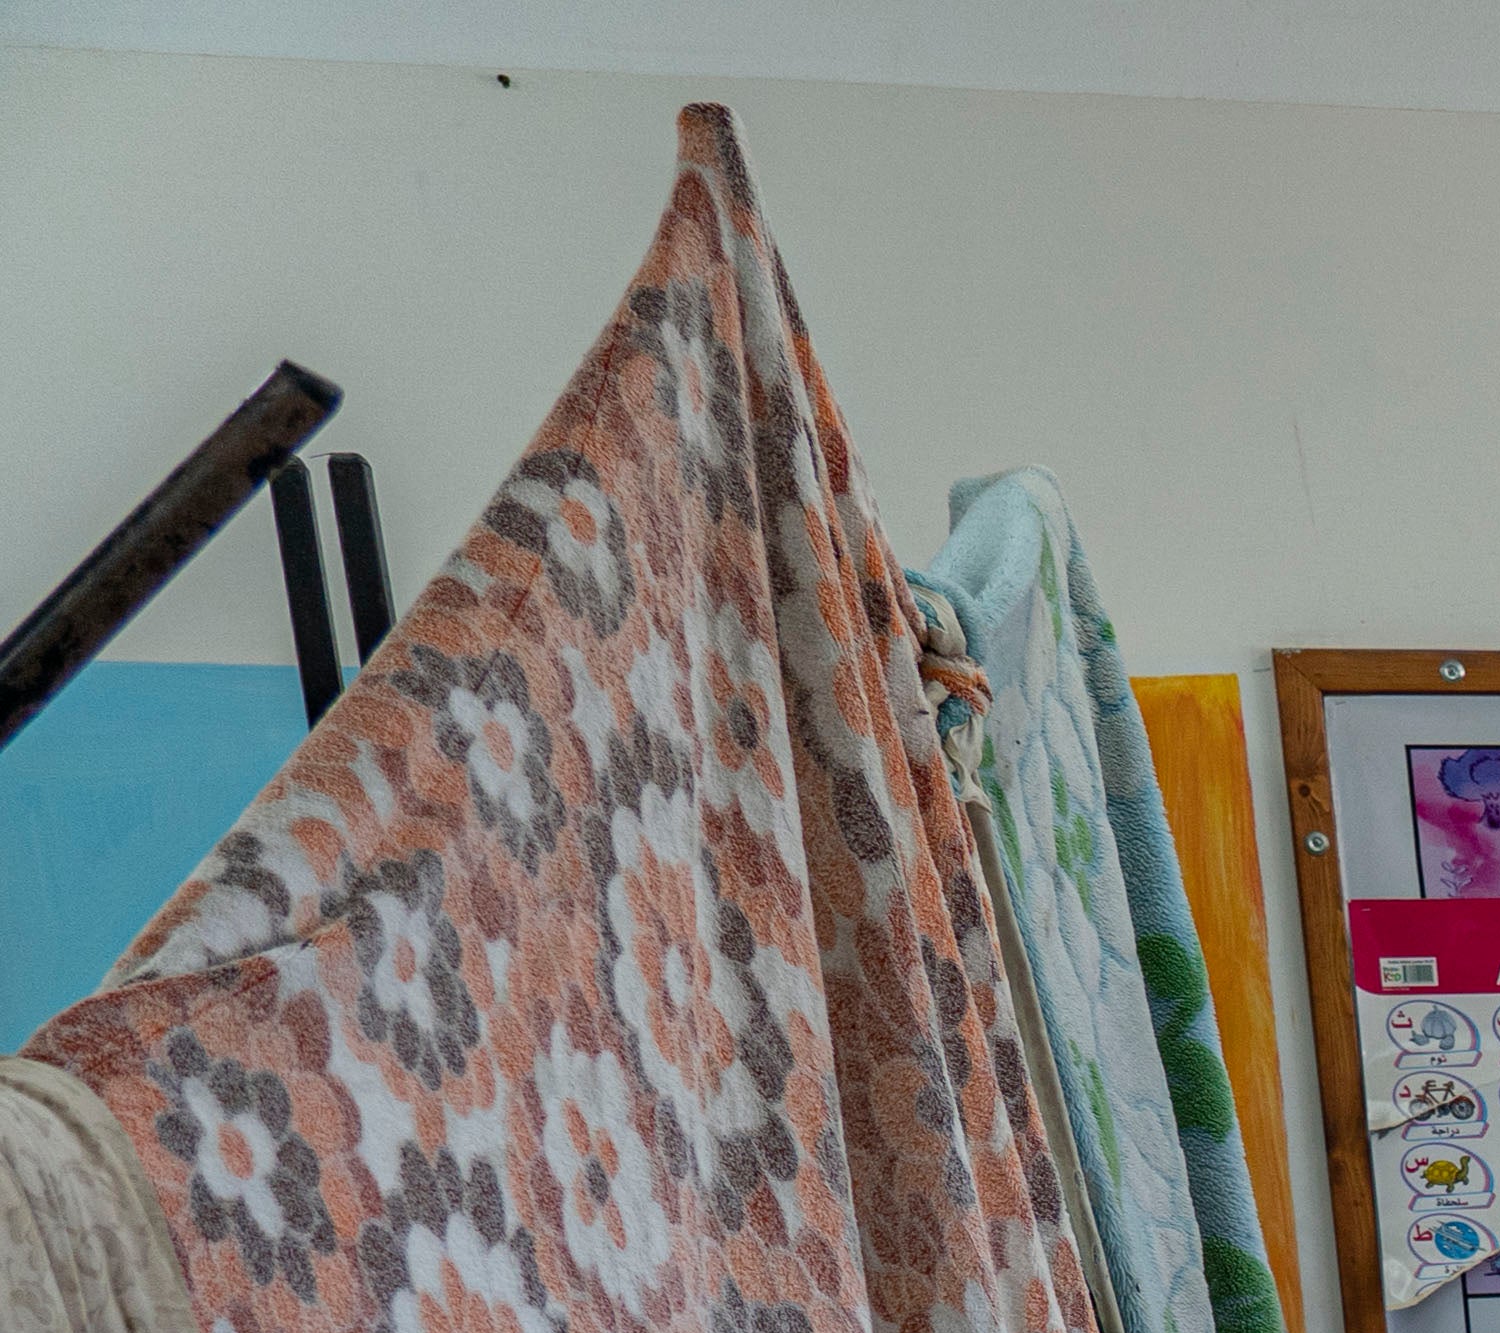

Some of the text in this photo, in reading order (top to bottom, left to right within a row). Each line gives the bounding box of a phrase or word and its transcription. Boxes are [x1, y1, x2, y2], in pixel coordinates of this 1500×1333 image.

[1391, 1010, 1413, 1028] ث
[1399, 1085, 1411, 1098] د
[1405, 1156, 1429, 1173] س
[1413, 1224, 1433, 1241] ط
